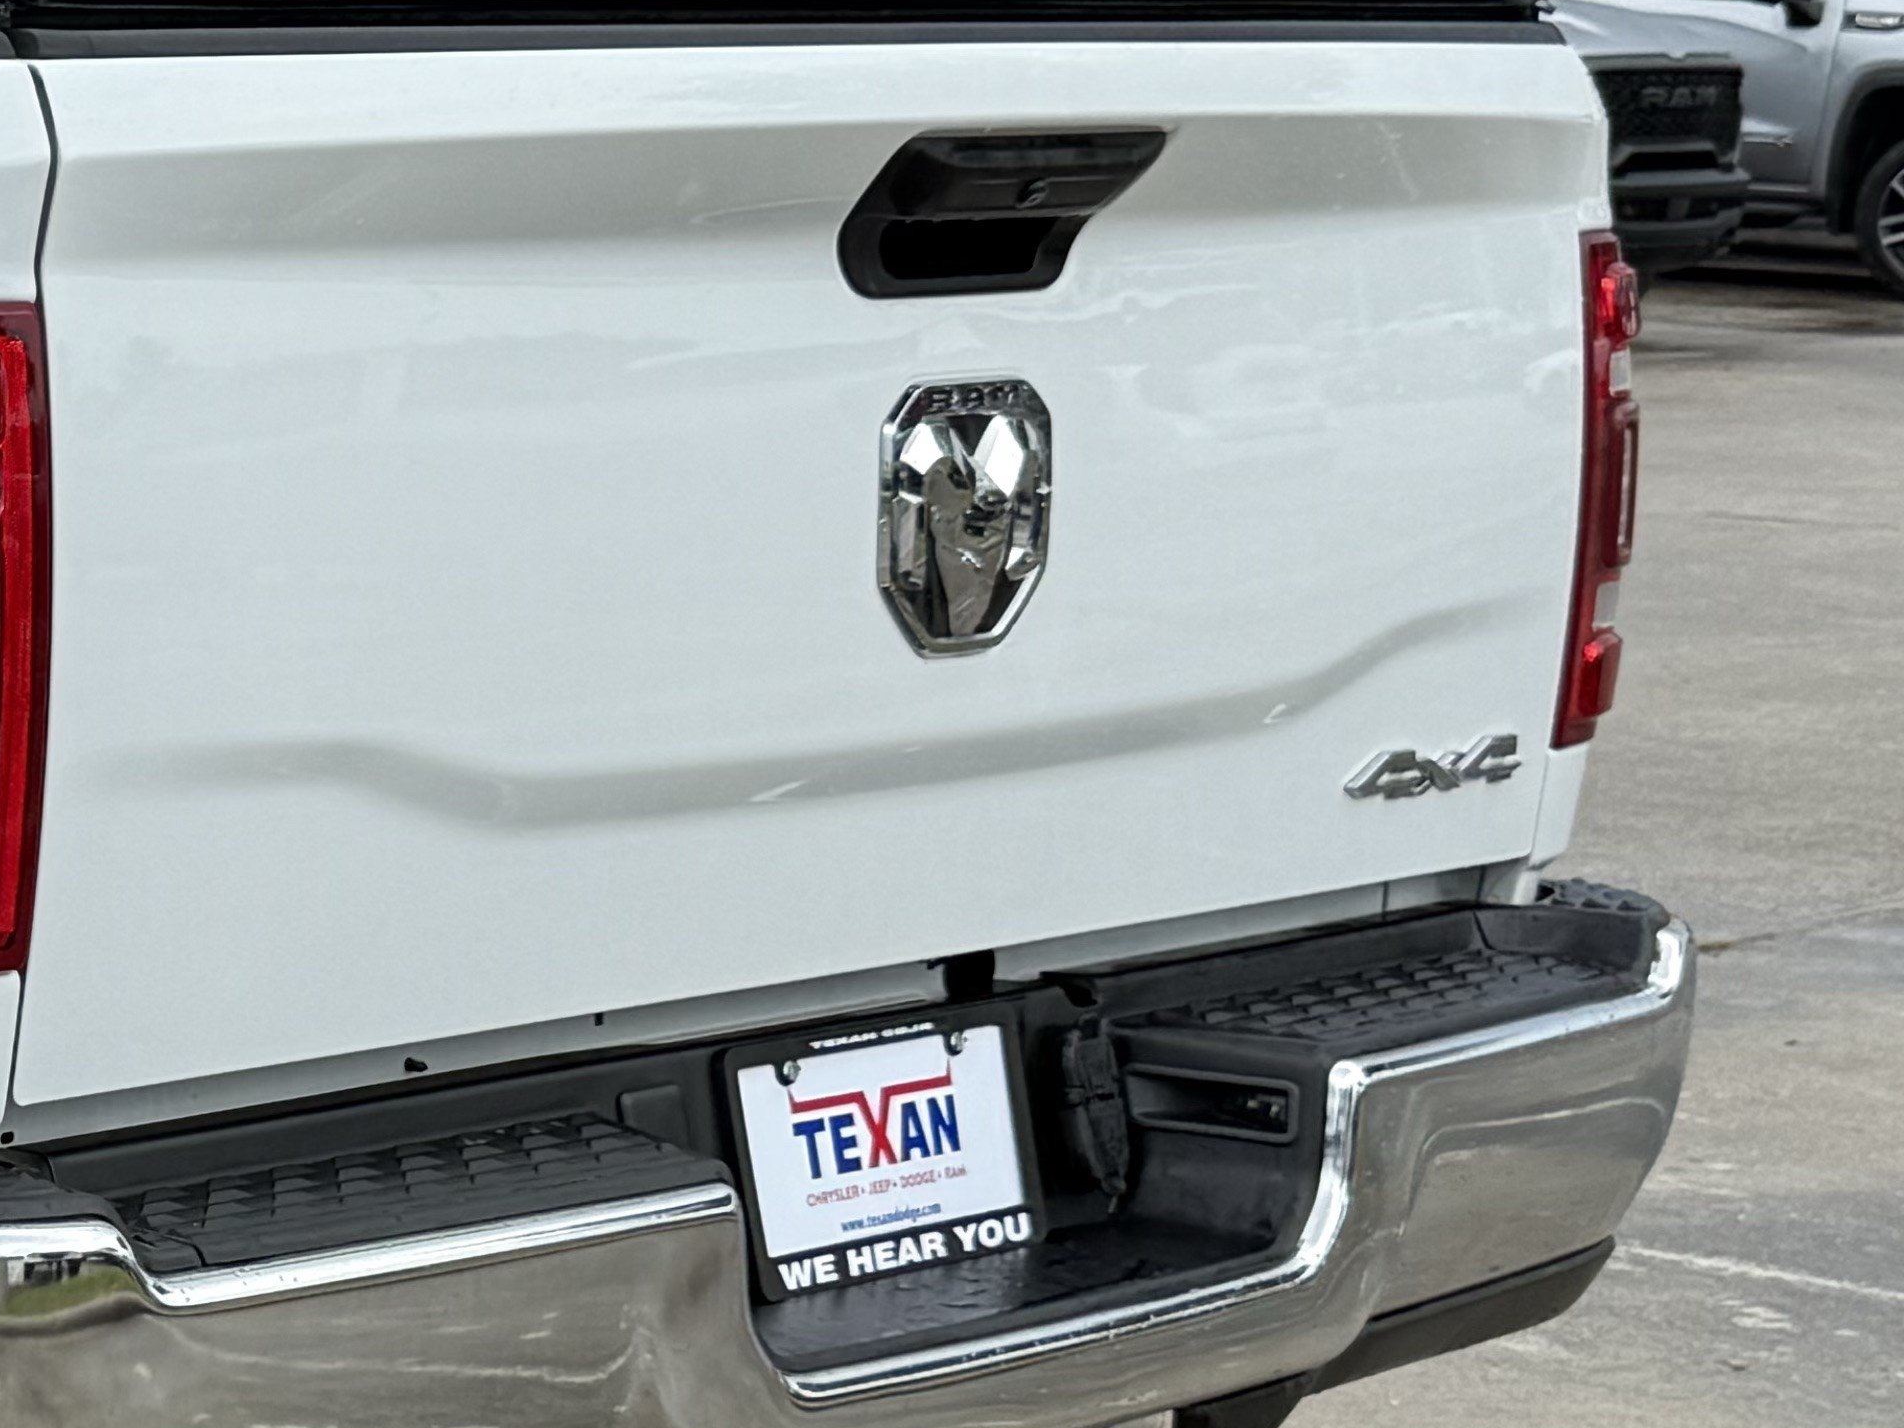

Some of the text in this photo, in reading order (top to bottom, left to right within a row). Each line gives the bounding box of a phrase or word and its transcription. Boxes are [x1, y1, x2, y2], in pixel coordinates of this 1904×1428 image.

[809, 1031, 879, 1050] TEXAN
[791, 1081, 961, 1180] TEXAN
[806, 1164, 968, 1207] CHRYSLER JEEP DODGE RAM
[841, 1202, 943, 1233] www.texandodge.com
[777, 1211, 1033, 1291] WE HEAR YOU
